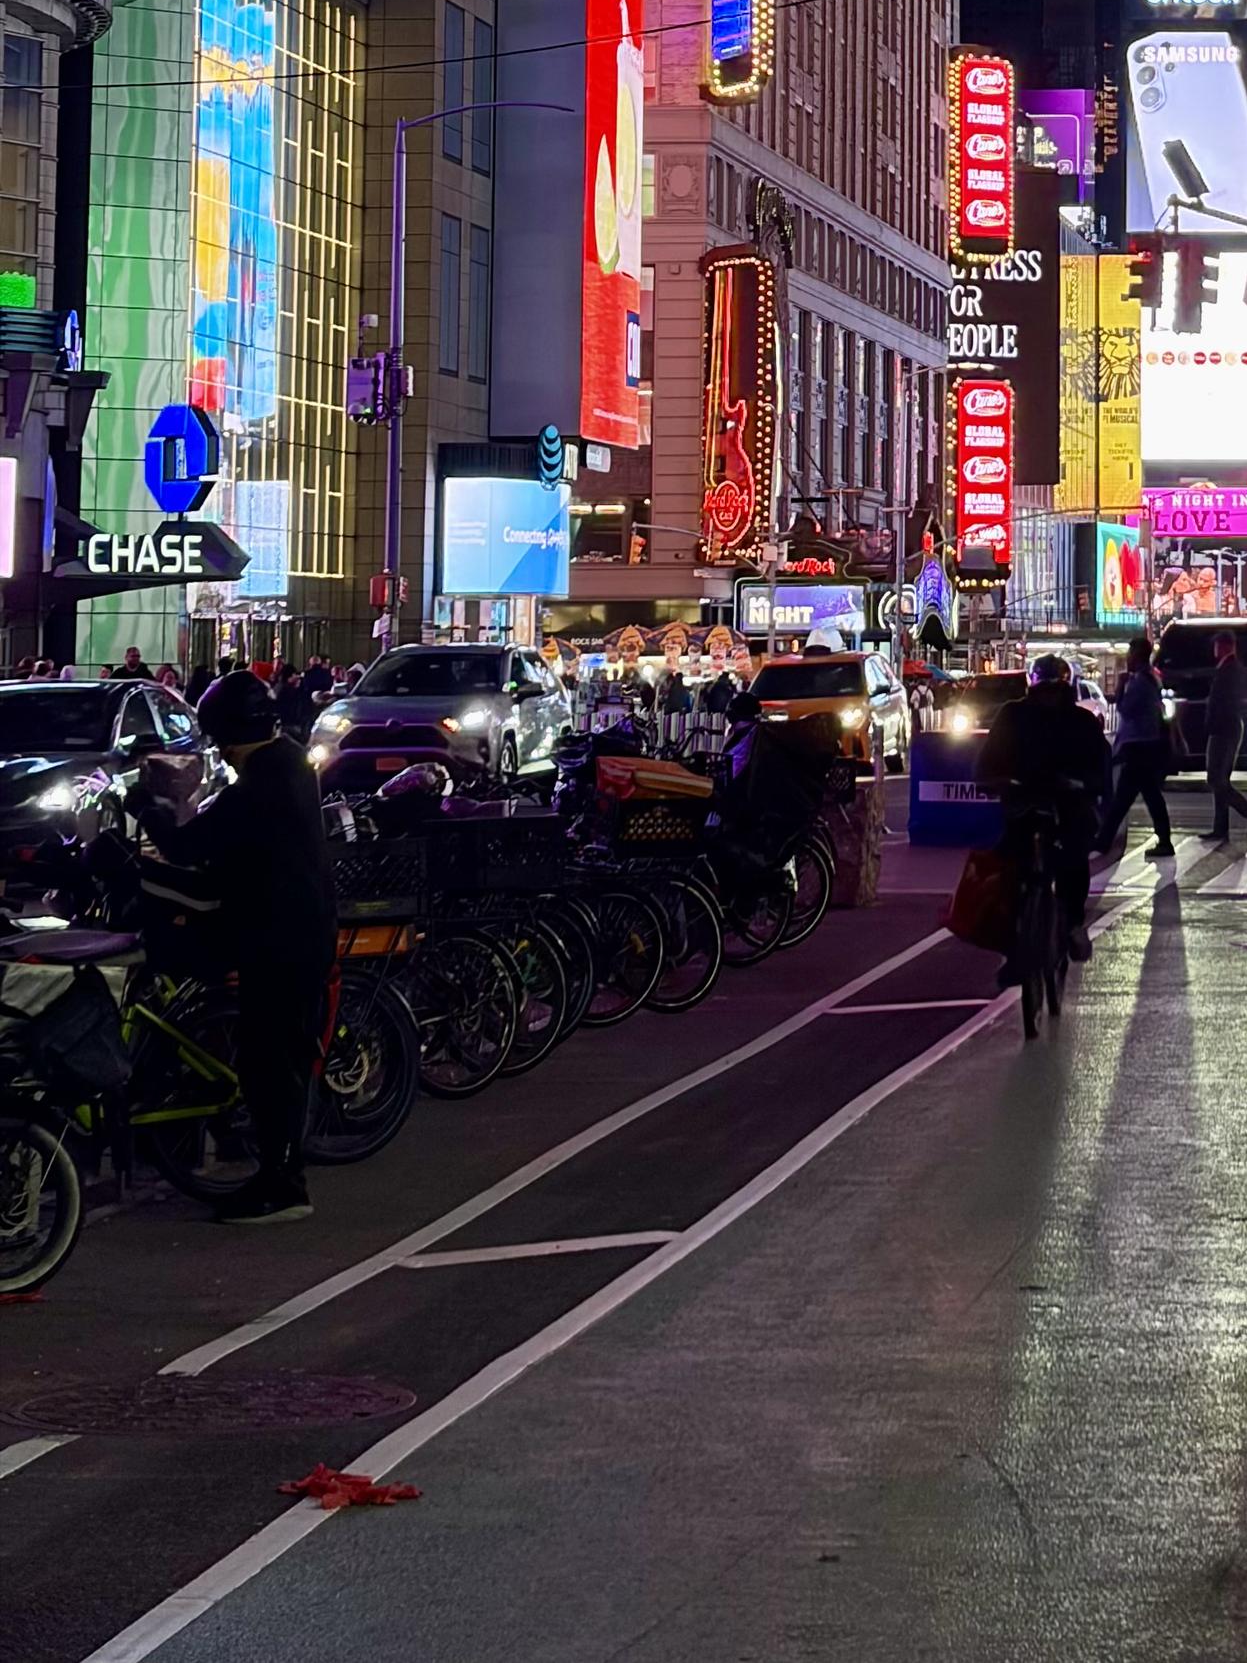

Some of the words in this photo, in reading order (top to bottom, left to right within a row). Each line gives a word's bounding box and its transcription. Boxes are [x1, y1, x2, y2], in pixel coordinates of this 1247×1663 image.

[1143, 46, 1240, 65] SAMSUNG
[947, 324, 1018, 358] EOPLE
[964, 391, 1006, 415] Cane's
[1110, 415, 1139, 424] MUSICAL
[963, 458, 1006, 482] Cane's
[1172, 494, 1225, 508] NIGHT
[1153, 510, 1232, 532] LOVE
[88, 533, 204, 574] CHASE
[749, 606, 815, 625] NIGHT
[943, 783, 987, 801] TIM
